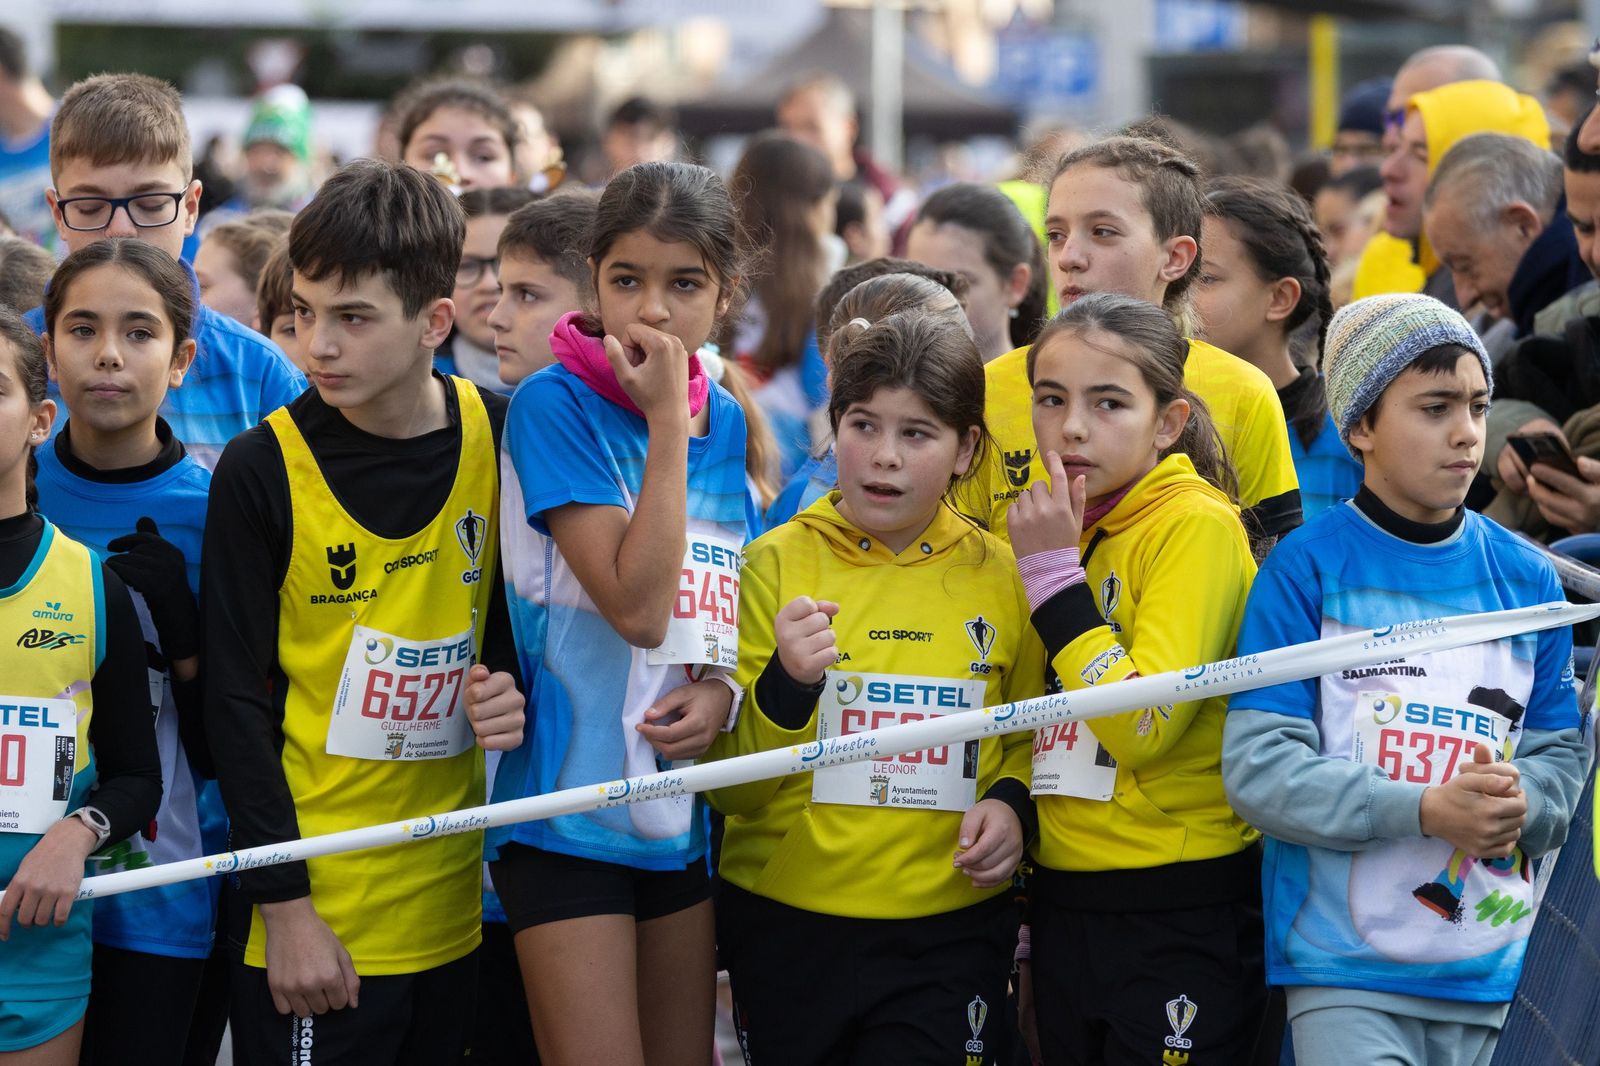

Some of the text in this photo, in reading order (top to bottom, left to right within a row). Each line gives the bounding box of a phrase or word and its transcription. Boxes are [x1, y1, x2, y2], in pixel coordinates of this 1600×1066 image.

[400, 549, 439, 569] SPORT
[311, 588, 378, 604] BRAGANÇA
[32, 610, 74, 622] amura
[869, 629, 935, 643] CCI SPORT
[1363, 626, 1447, 650] SALMANTINA
[970, 662, 993, 675] GCB
[1342, 665, 1428, 680] SALMANTINA
[1175, 667, 1263, 692] SALMANTINA
[361, 668, 464, 721] 6527
[867, 682, 971, 708] SETEL
[381, 720, 442, 732] GUILHERME
[983, 709, 1072, 732] SALMANTINA
[1405, 702, 1498, 742] SETEL
[406, 739, 449, 749] Ayuntamiento
[404, 749, 447, 758] de Salamanca
[791, 750, 880, 772] SALMANTINA
[873, 763, 917, 775] LEONOR
[892, 785, 938, 796] Ayuntamiento
[596, 789, 686, 809] SALMANTINA
[901, 797, 937, 806] Salamanca
[966, 1040, 983, 1052] GCB
[1165, 1036, 1192, 1048] GCB
